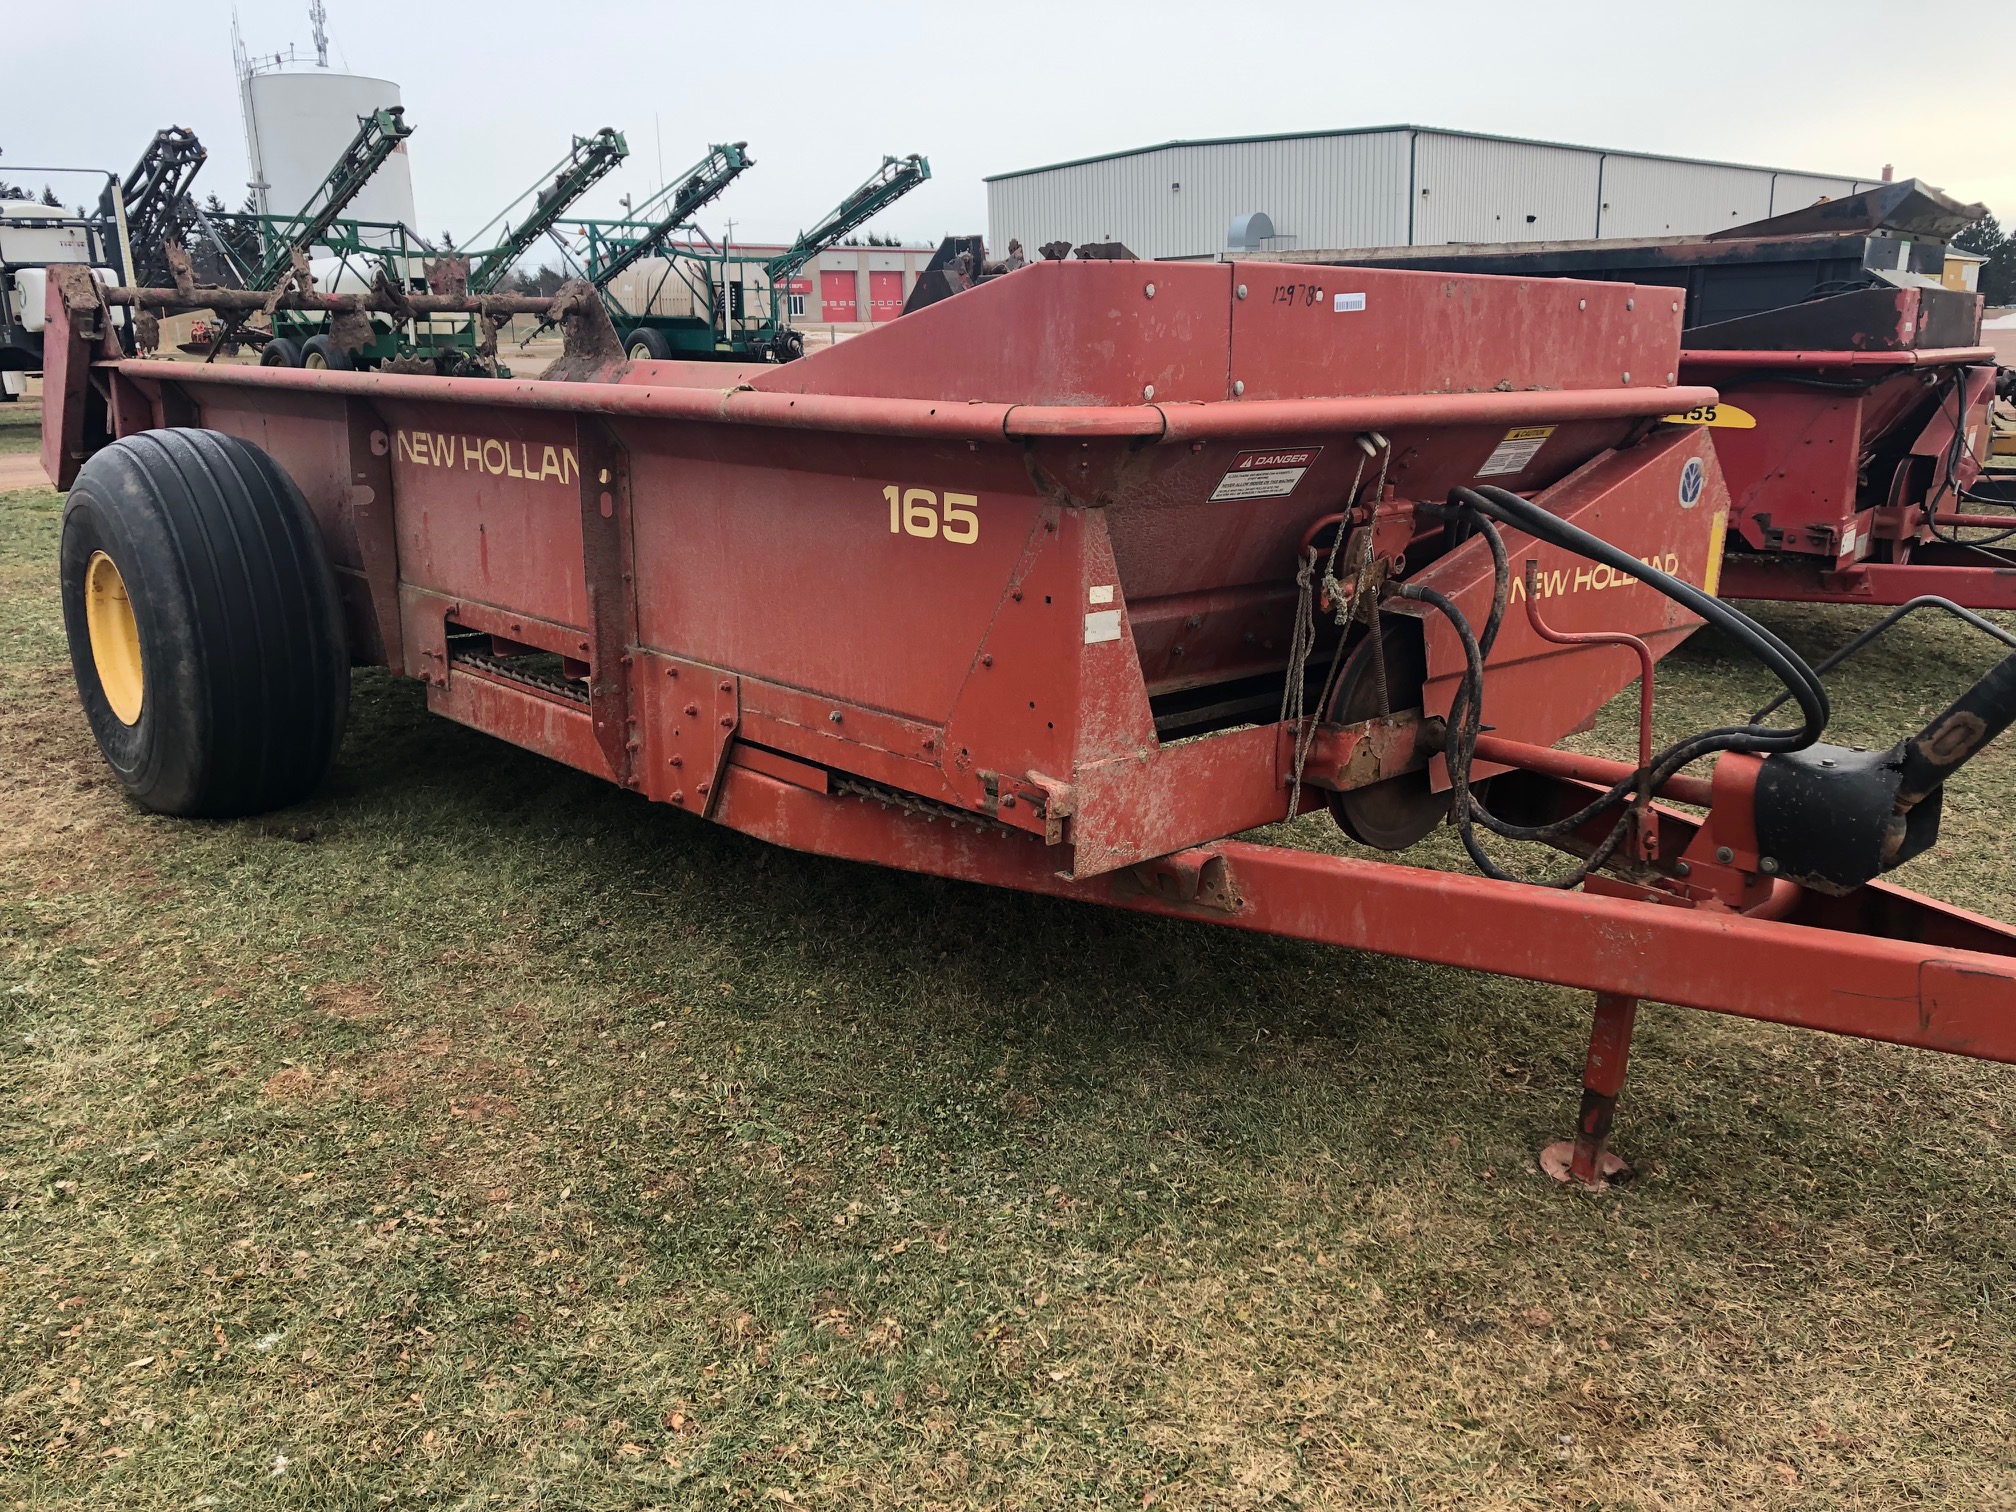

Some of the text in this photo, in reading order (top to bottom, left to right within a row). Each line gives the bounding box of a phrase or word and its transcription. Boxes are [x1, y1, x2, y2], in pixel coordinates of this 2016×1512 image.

[834, 277, 839, 285] 1
[882, 277, 887, 285] 2
[1520, 429, 1545, 438] CAUTION
[398, 430, 607, 485] NEW HOLLAN
[1254, 454, 1308, 466] DANGER
[882, 485, 979, 545] 165
[1510, 568, 1570, 604] NEW
